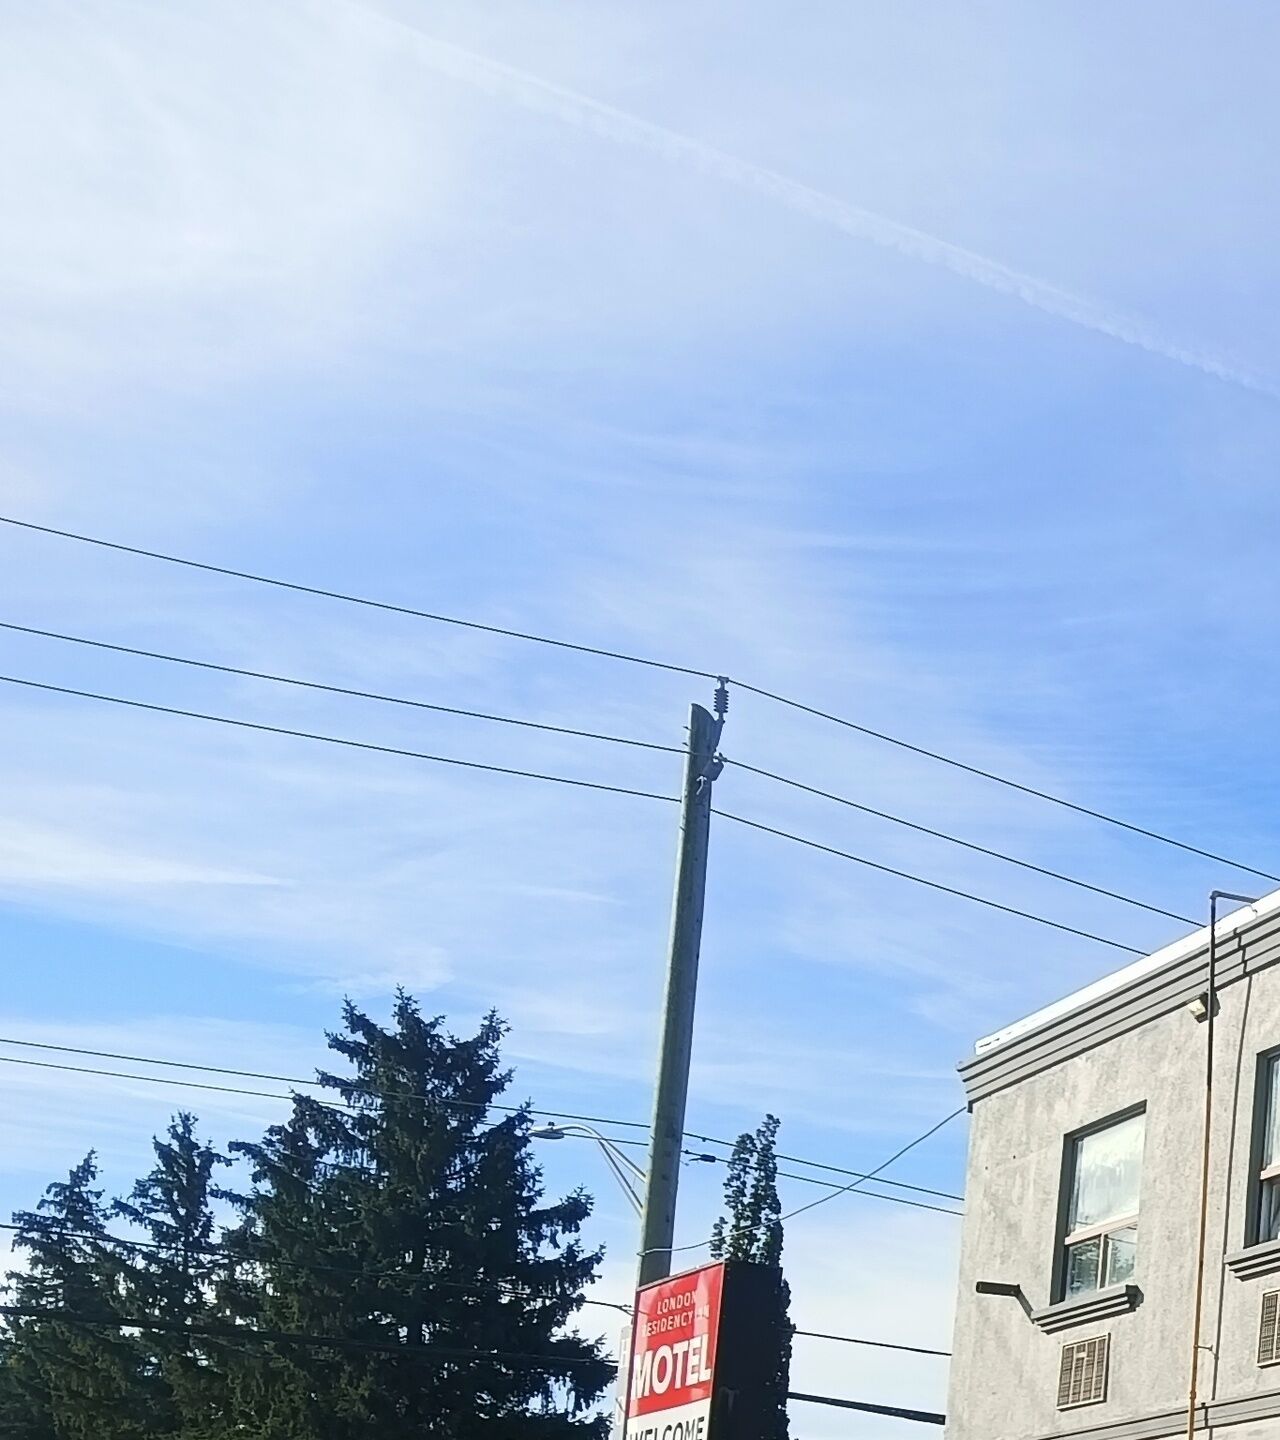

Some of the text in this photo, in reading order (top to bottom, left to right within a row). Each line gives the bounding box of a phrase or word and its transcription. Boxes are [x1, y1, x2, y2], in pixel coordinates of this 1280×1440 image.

[657, 1291, 697, 1314] LONDON
[642, 1311, 693, 1338] ESIDENCY
[631, 1333, 711, 1400] MOTEL
